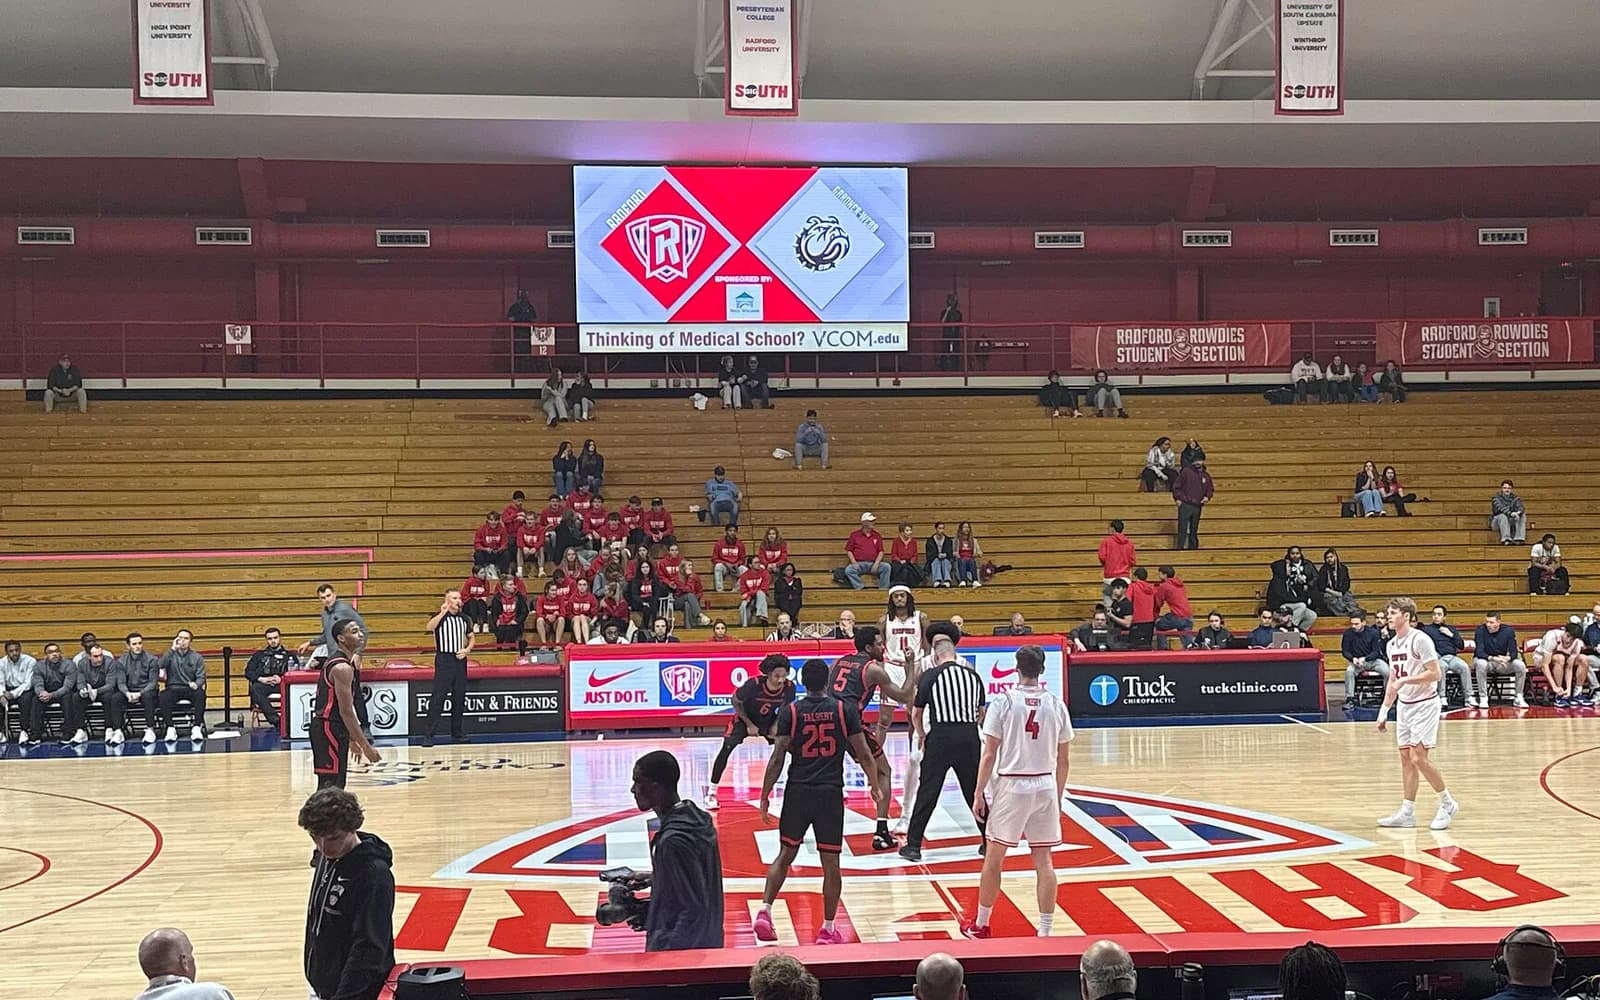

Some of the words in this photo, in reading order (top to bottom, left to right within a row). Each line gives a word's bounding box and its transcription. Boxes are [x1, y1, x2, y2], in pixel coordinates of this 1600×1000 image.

[149, 1, 191, 9] UNIVERSITY
[586, 332, 654, 350] Thinking
[659, 331, 674, 347] of
[679, 331, 740, 347] Medical
[745, 331, 805, 347] School?
[1117, 328, 1172, 345] RADFORD
[1189, 327, 1245, 343] ROWDIES
[1421, 325, 1477, 342] RADFORD
[1493, 323, 1549, 340] ROWDIES
[539, 345, 548, 356] 12
[1117, 346, 1170, 363] STUDENT
[1192, 345, 1246, 362] SECTION
[1422, 343, 1474, 359] STUDENT
[1497, 341, 1550, 358] SECTION
[833, 667, 851, 692] 5
[1122, 674, 1176, 697] Tuck
[1200, 681, 1298, 694] tuckclinic.com
[489, 695, 500, 711] &
[503, 695, 559, 710] FRIENDS
[583, 690, 612, 704] JUST
[614, 690, 632, 703] DO
[760, 703, 771, 715] 6
[1025, 709, 1040, 740] 4
[801, 722, 837, 758] 25
